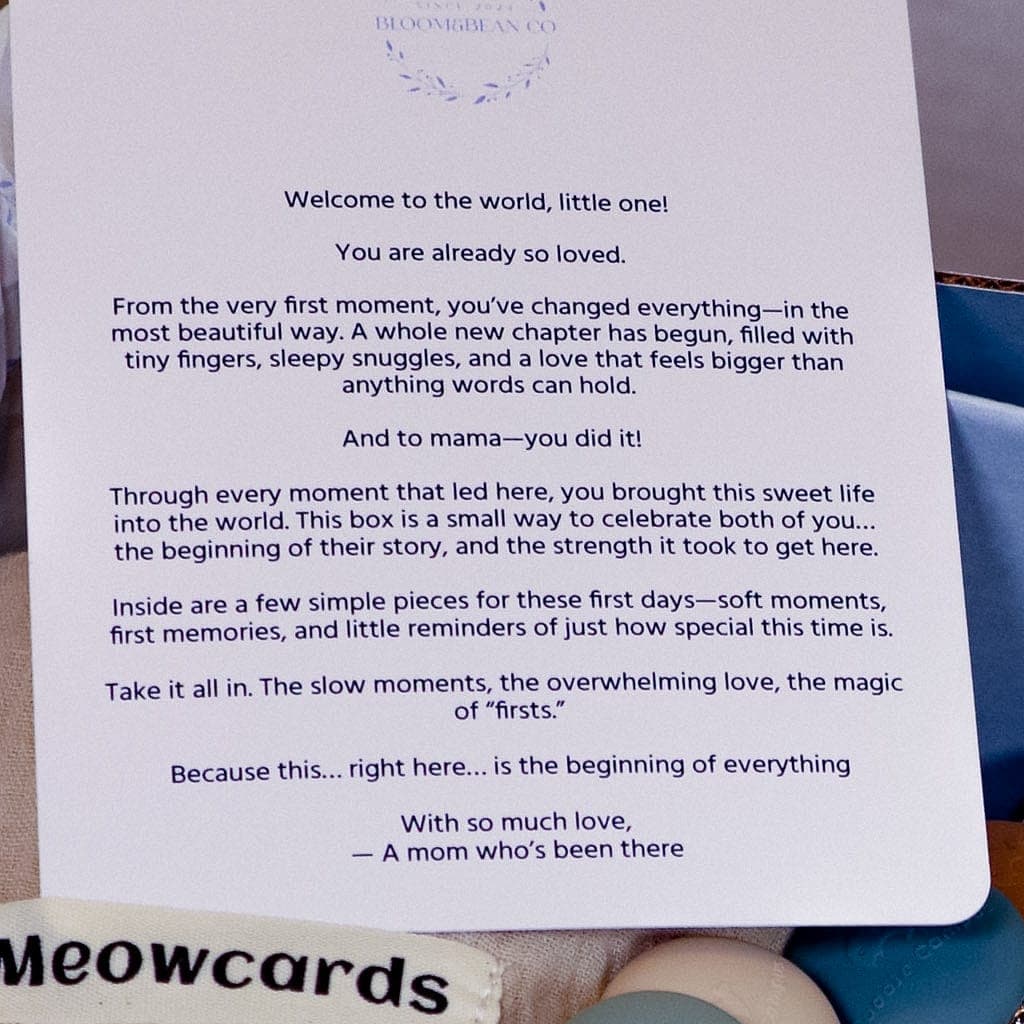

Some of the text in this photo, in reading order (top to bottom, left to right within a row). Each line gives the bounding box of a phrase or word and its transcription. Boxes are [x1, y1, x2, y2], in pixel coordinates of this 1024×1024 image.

[527, 19, 557, 34] CO
[283, 189, 669, 214] Welcome to the world, little one!
[334, 242, 626, 266] You are already so loved.
[112, 297, 173, 316] From
[179, 295, 220, 315] the
[225, 299, 278, 319] very
[283, 294, 329, 315] first
[335, 296, 441, 317] moment,
[446, 295, 524, 319] you’ve
[531, 296, 631, 320] changed
[810, 300, 849, 320] the
[111, 321, 854, 348] most beautiful way. A whole new chapter has begun, filled with
[124, 347, 844, 375] tiny fingers, sleepy snuggles, and a love that feels bigger than
[342, 374, 637, 398] anything words can hold.
[342, 427, 390, 448] And
[396, 429, 423, 448] to
[574, 428, 612, 448] did
[619, 428, 642, 448] it!
[108, 481, 876, 510] Through every moment that led here, you brought this sweet life
[114, 513, 162, 534] into
[167, 512, 209, 533] the
[214, 510, 290, 532] world.
[295, 509, 343, 530] This
[349, 509, 395, 529] box
[401, 508, 419, 529] is
[426, 513, 439, 528] a
[446, 508, 506, 528] small
[513, 512, 562, 532] way
[568, 510, 595, 528] to
[601, 508, 712, 529] celebrate
[719, 508, 775, 529] both
[781, 509, 806, 529] of
[113, 535, 879, 564] the beginning of their story, and the strength it took to get here.
[113, 595, 183, 617] Inside
[190, 599, 228, 615] are
[234, 598, 248, 614] a
[255, 592, 302, 613] few
[308, 591, 386, 616] simple
[393, 590, 470, 615] pieces
[475, 589, 511, 610] for
[515, 589, 582, 609] these
[588, 589, 635, 609] first
[770, 592, 887, 613] moments,
[109, 616, 894, 646] first memories, and little reminders of just how special this time is.
[104, 671, 904, 702] Take it all in. The slow moments, the overwhelming love, the magic
[454, 700, 479, 721] of
[170, 764, 270, 784] Because
[349, 757, 406, 783] right
[493, 755, 512, 776] is
[518, 755, 559, 776] the
[566, 753, 685, 779] beginning
[692, 753, 717, 774] of
[723, 753, 851, 779] everything
[400, 810, 632, 834] With so much love,
[382, 843, 400, 863] A
[407, 845, 469, 862] mom
[475, 839, 547, 861] who’s
[553, 839, 614, 860] been
[619, 838, 685, 859] there
[0, 934, 450, 1016] Meowcards
